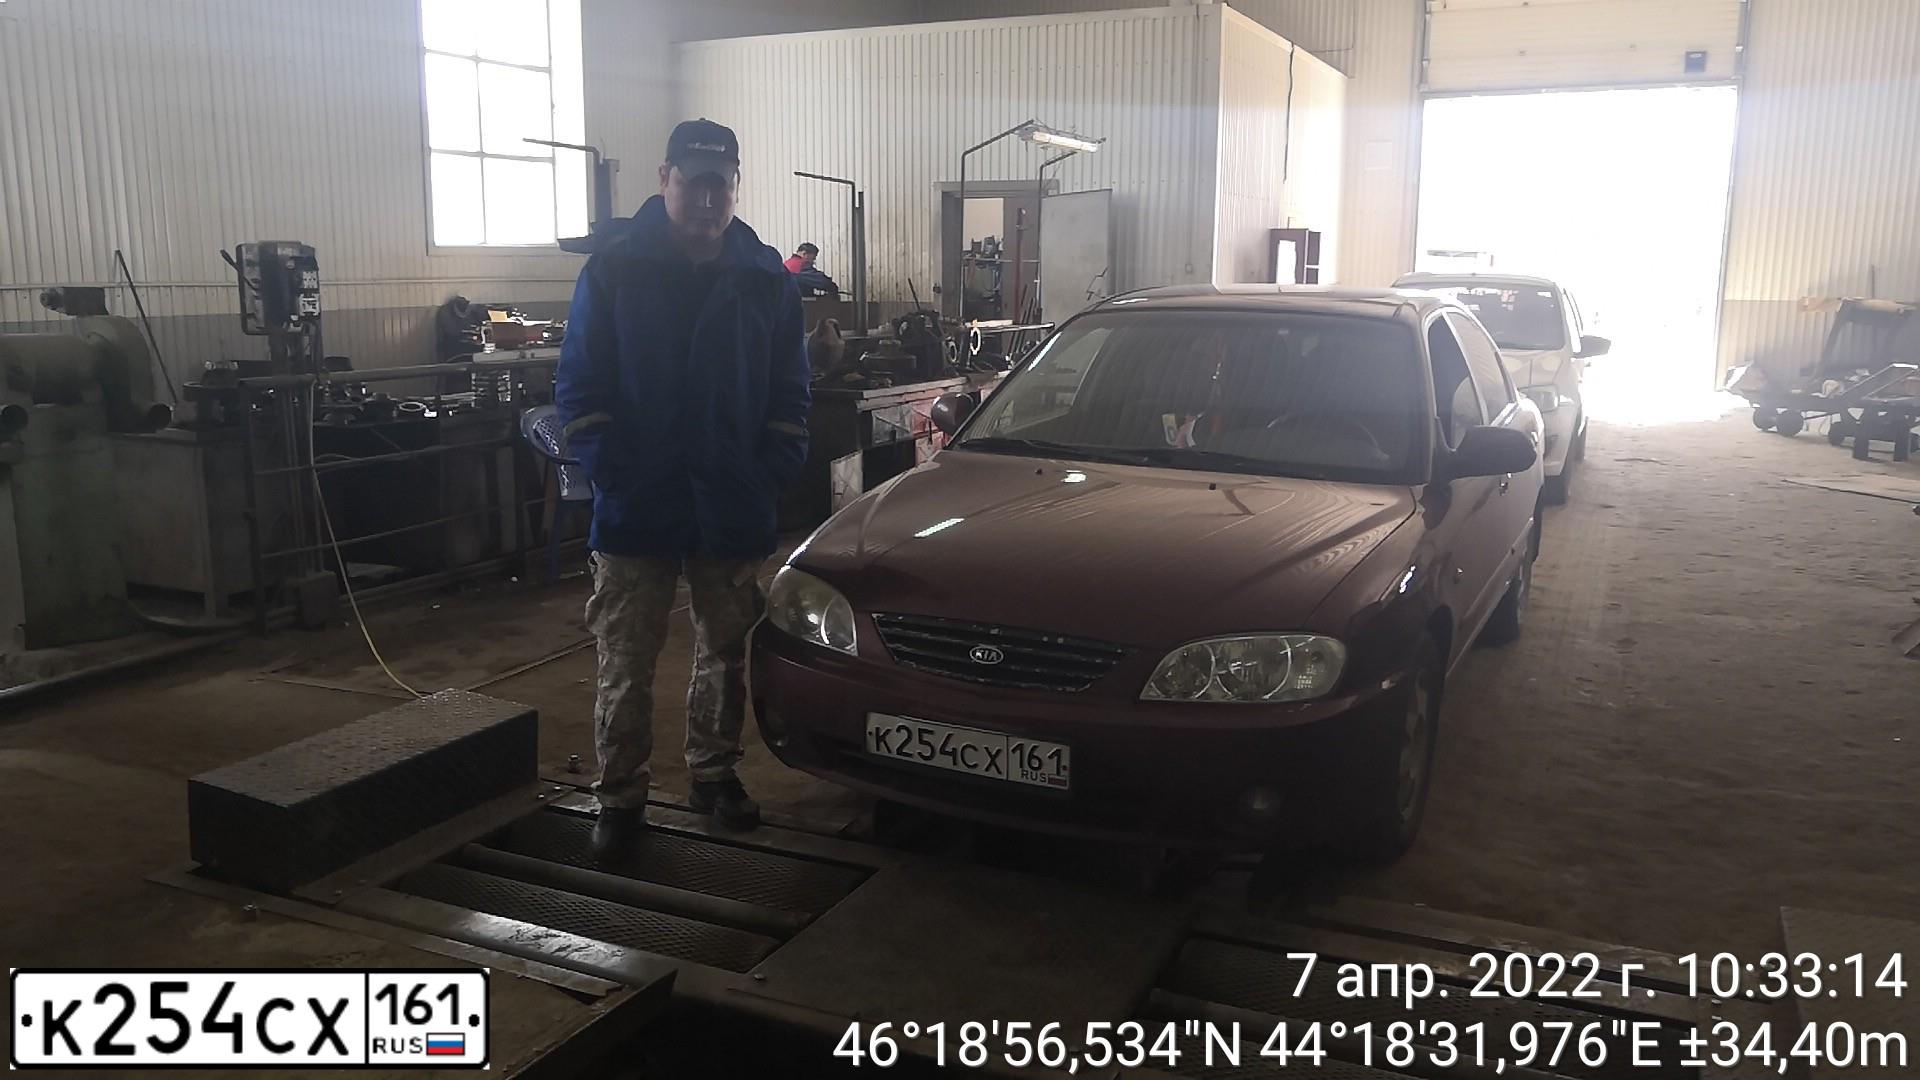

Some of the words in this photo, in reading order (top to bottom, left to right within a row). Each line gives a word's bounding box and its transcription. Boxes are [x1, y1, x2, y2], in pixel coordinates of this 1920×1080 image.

[975, 649, 998, 661] KIA
[1011, 742, 1063, 777] 161
[1020, 768, 1047, 784] RUS
